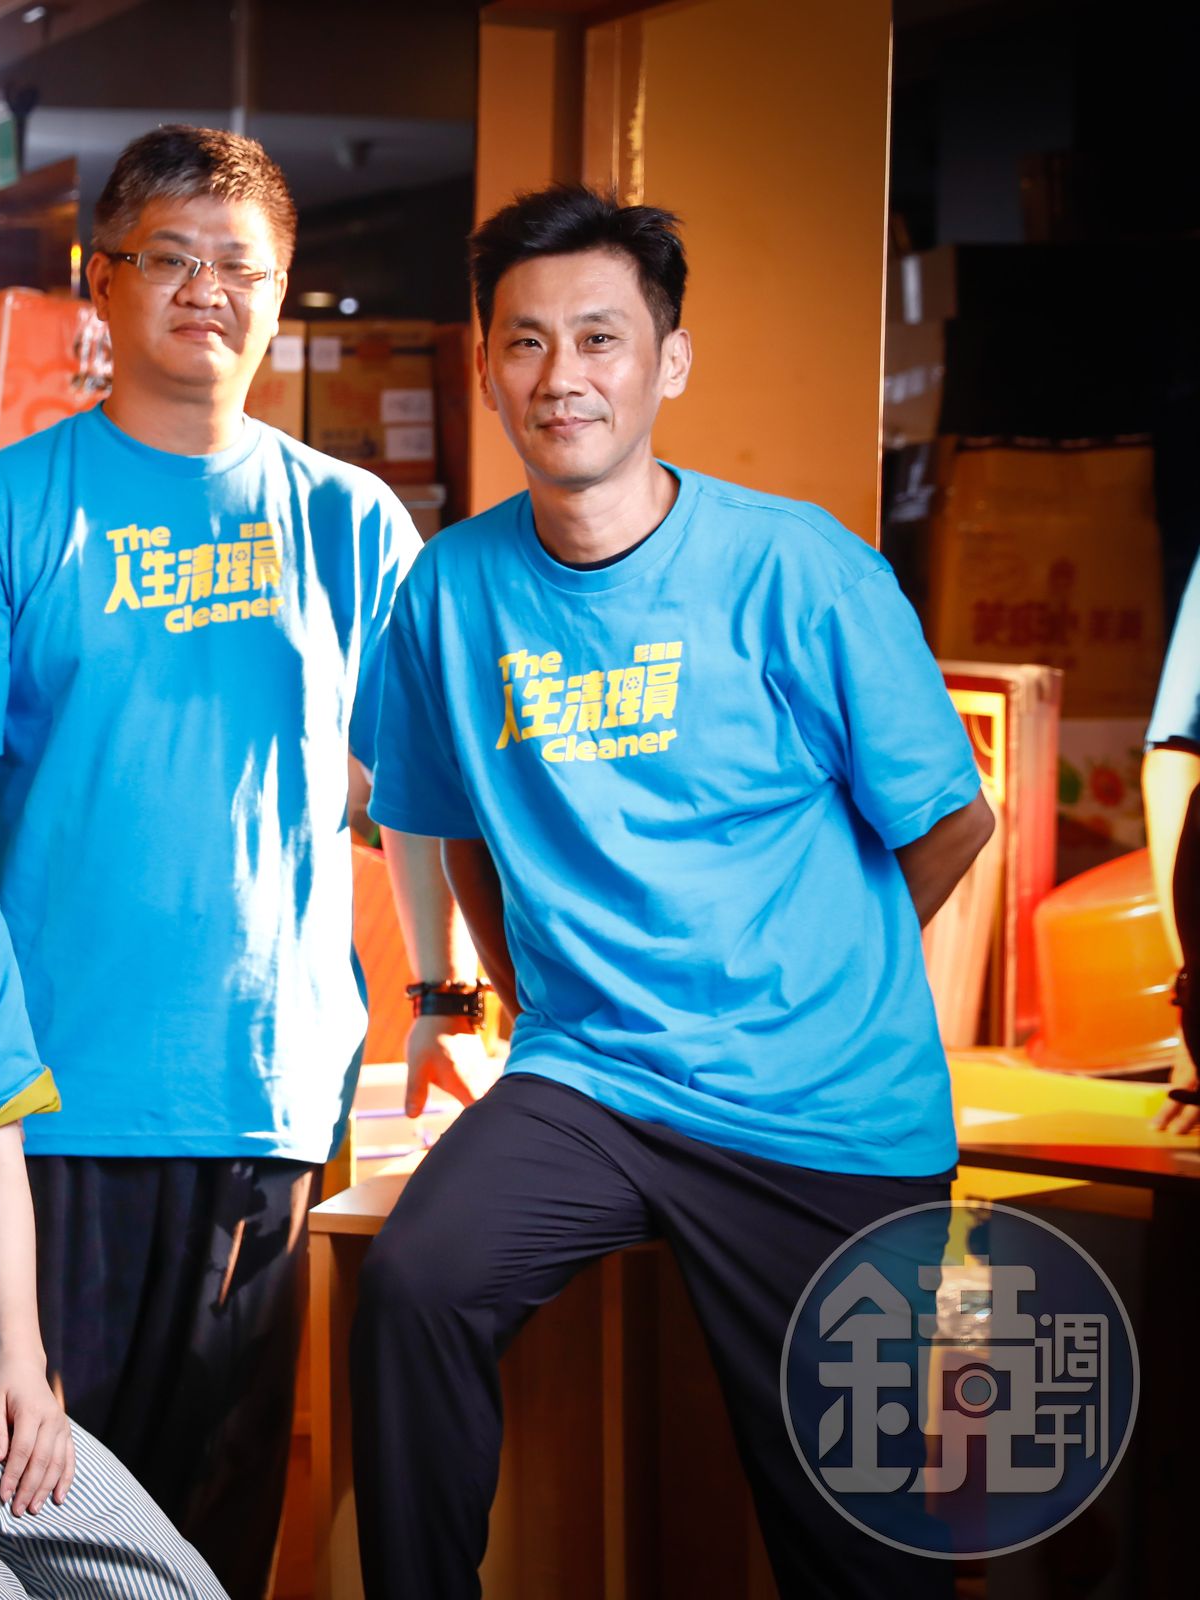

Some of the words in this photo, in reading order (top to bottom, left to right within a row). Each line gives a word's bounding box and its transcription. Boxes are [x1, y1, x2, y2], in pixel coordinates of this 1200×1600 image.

[106, 524, 171, 553] The
[104, 539, 281, 614] 人生清理員
[164, 596, 285, 634] Cleaner
[498, 649, 563, 682] The
[496, 662, 681, 750] 人生清理員
[541, 729, 678, 762] Cleaner
